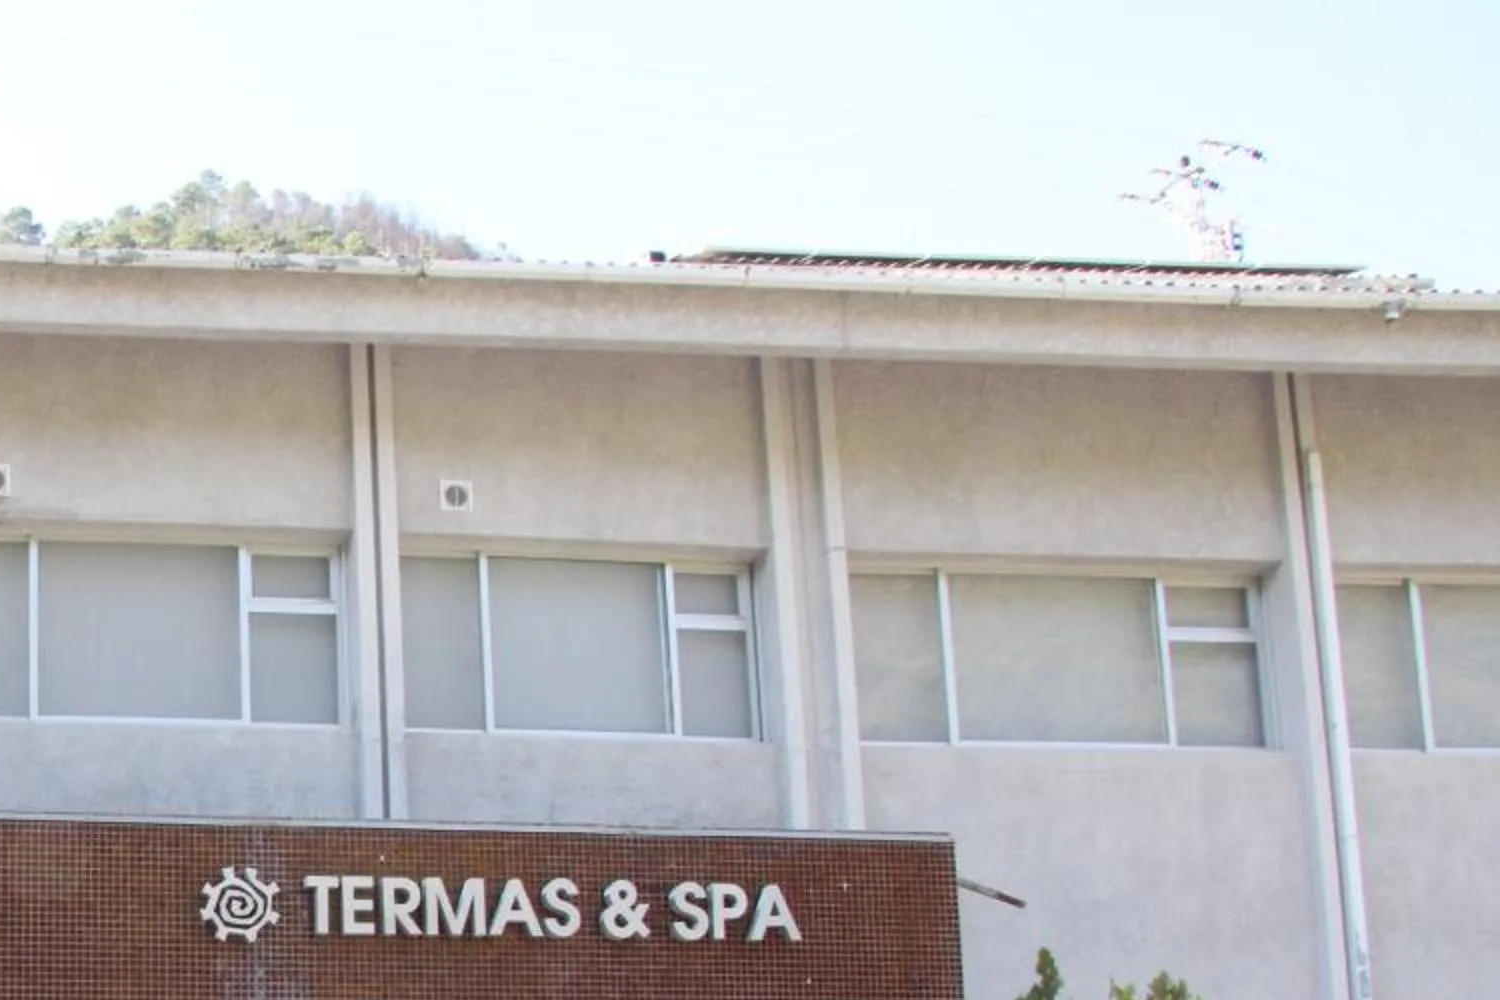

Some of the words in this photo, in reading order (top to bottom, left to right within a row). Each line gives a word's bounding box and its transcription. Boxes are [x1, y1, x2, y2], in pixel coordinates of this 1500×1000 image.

[303, 874, 581, 938] TERMAS
[600, 878, 651, 940] &
[668, 881, 802, 942] SPA
